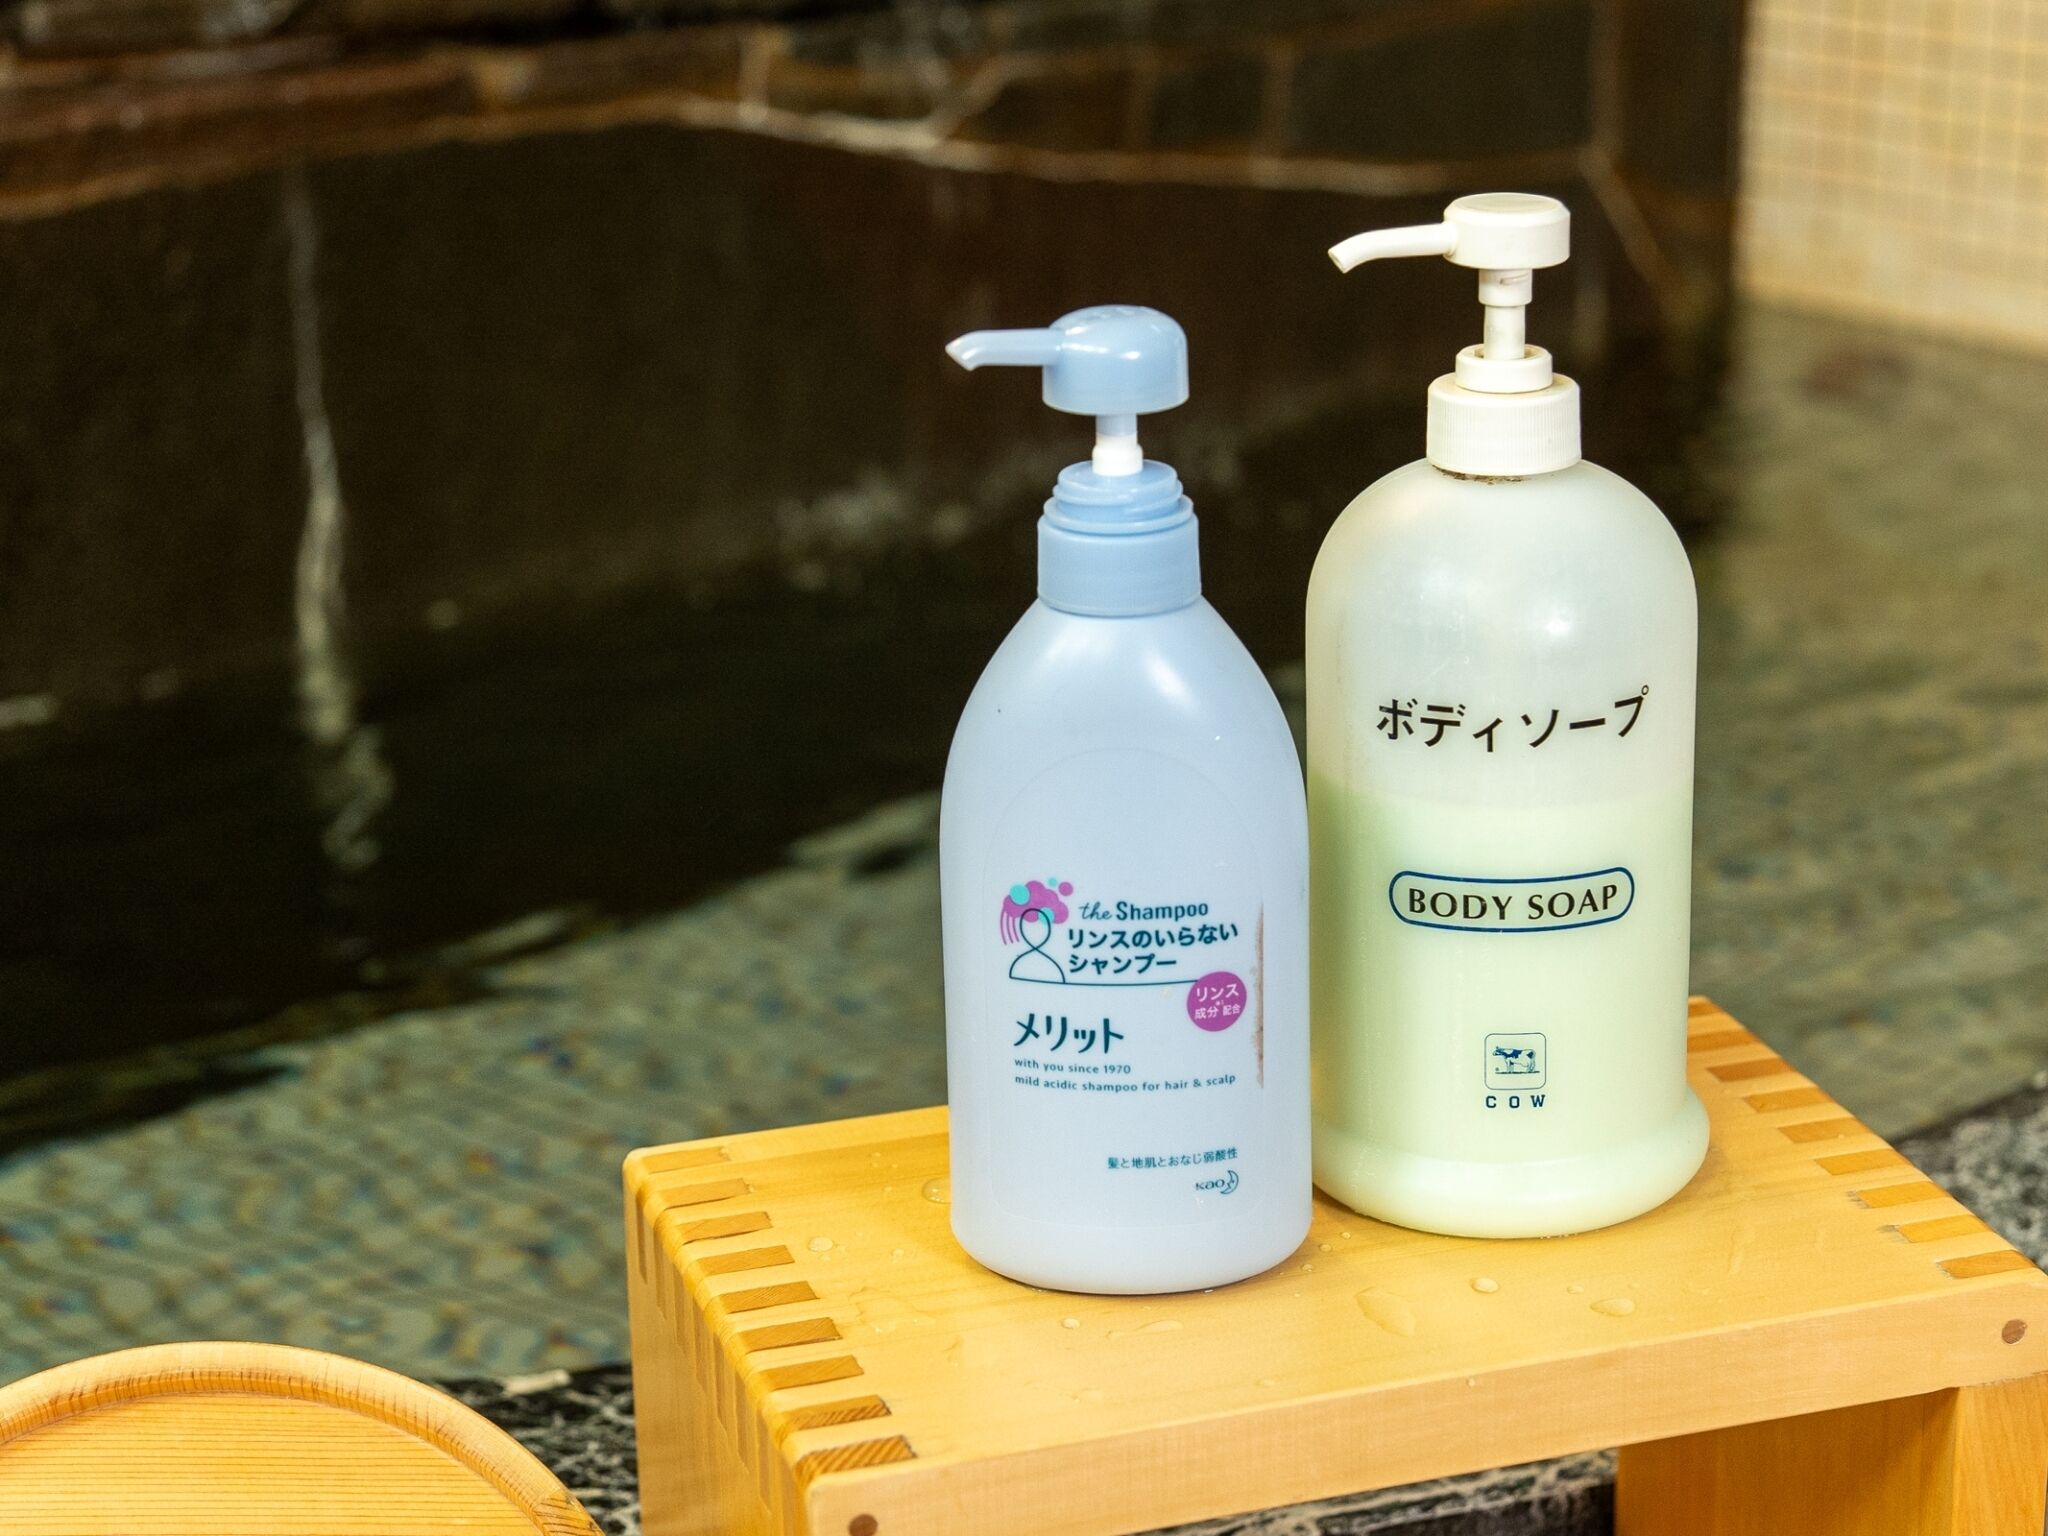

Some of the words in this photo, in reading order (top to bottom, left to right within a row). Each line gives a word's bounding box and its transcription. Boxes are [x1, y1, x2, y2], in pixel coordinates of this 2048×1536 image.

[1376, 684, 1650, 753] ボディソープ
[1078, 901, 1112, 920] the
[1115, 901, 1209, 922] Shampoo
[1408, 887, 1513, 921] BODY
[1527, 884, 1618, 920] SOAP
[1068, 923, 1239, 949] リンスのいらない
[1068, 953, 1177, 975] シャンプー
[1196, 983, 1240, 1002] リンス
[1013, 1013, 1124, 1054] メリット
[1014, 1058, 1039, 1069] with
[1043, 1062, 1064, 1072] you
[1068, 1063, 1099, 1074] since
[1103, 1064, 1131, 1074] 1970
[1015, 1075, 1040, 1087] mild
[1043, 1079, 1077, 1090] acidic
[1082, 1081, 1138, 1093] shampoo
[1142, 1081, 1160, 1091] for
[1164, 1080, 1188, 1090] hair
[1192, 1078, 1201, 1088] &
[1206, 1074, 1236, 1086] scalp
[1485, 1094, 1546, 1109] COW
[1107, 1147, 1238, 1169] 髪と地肌とおなじ弱酸性
